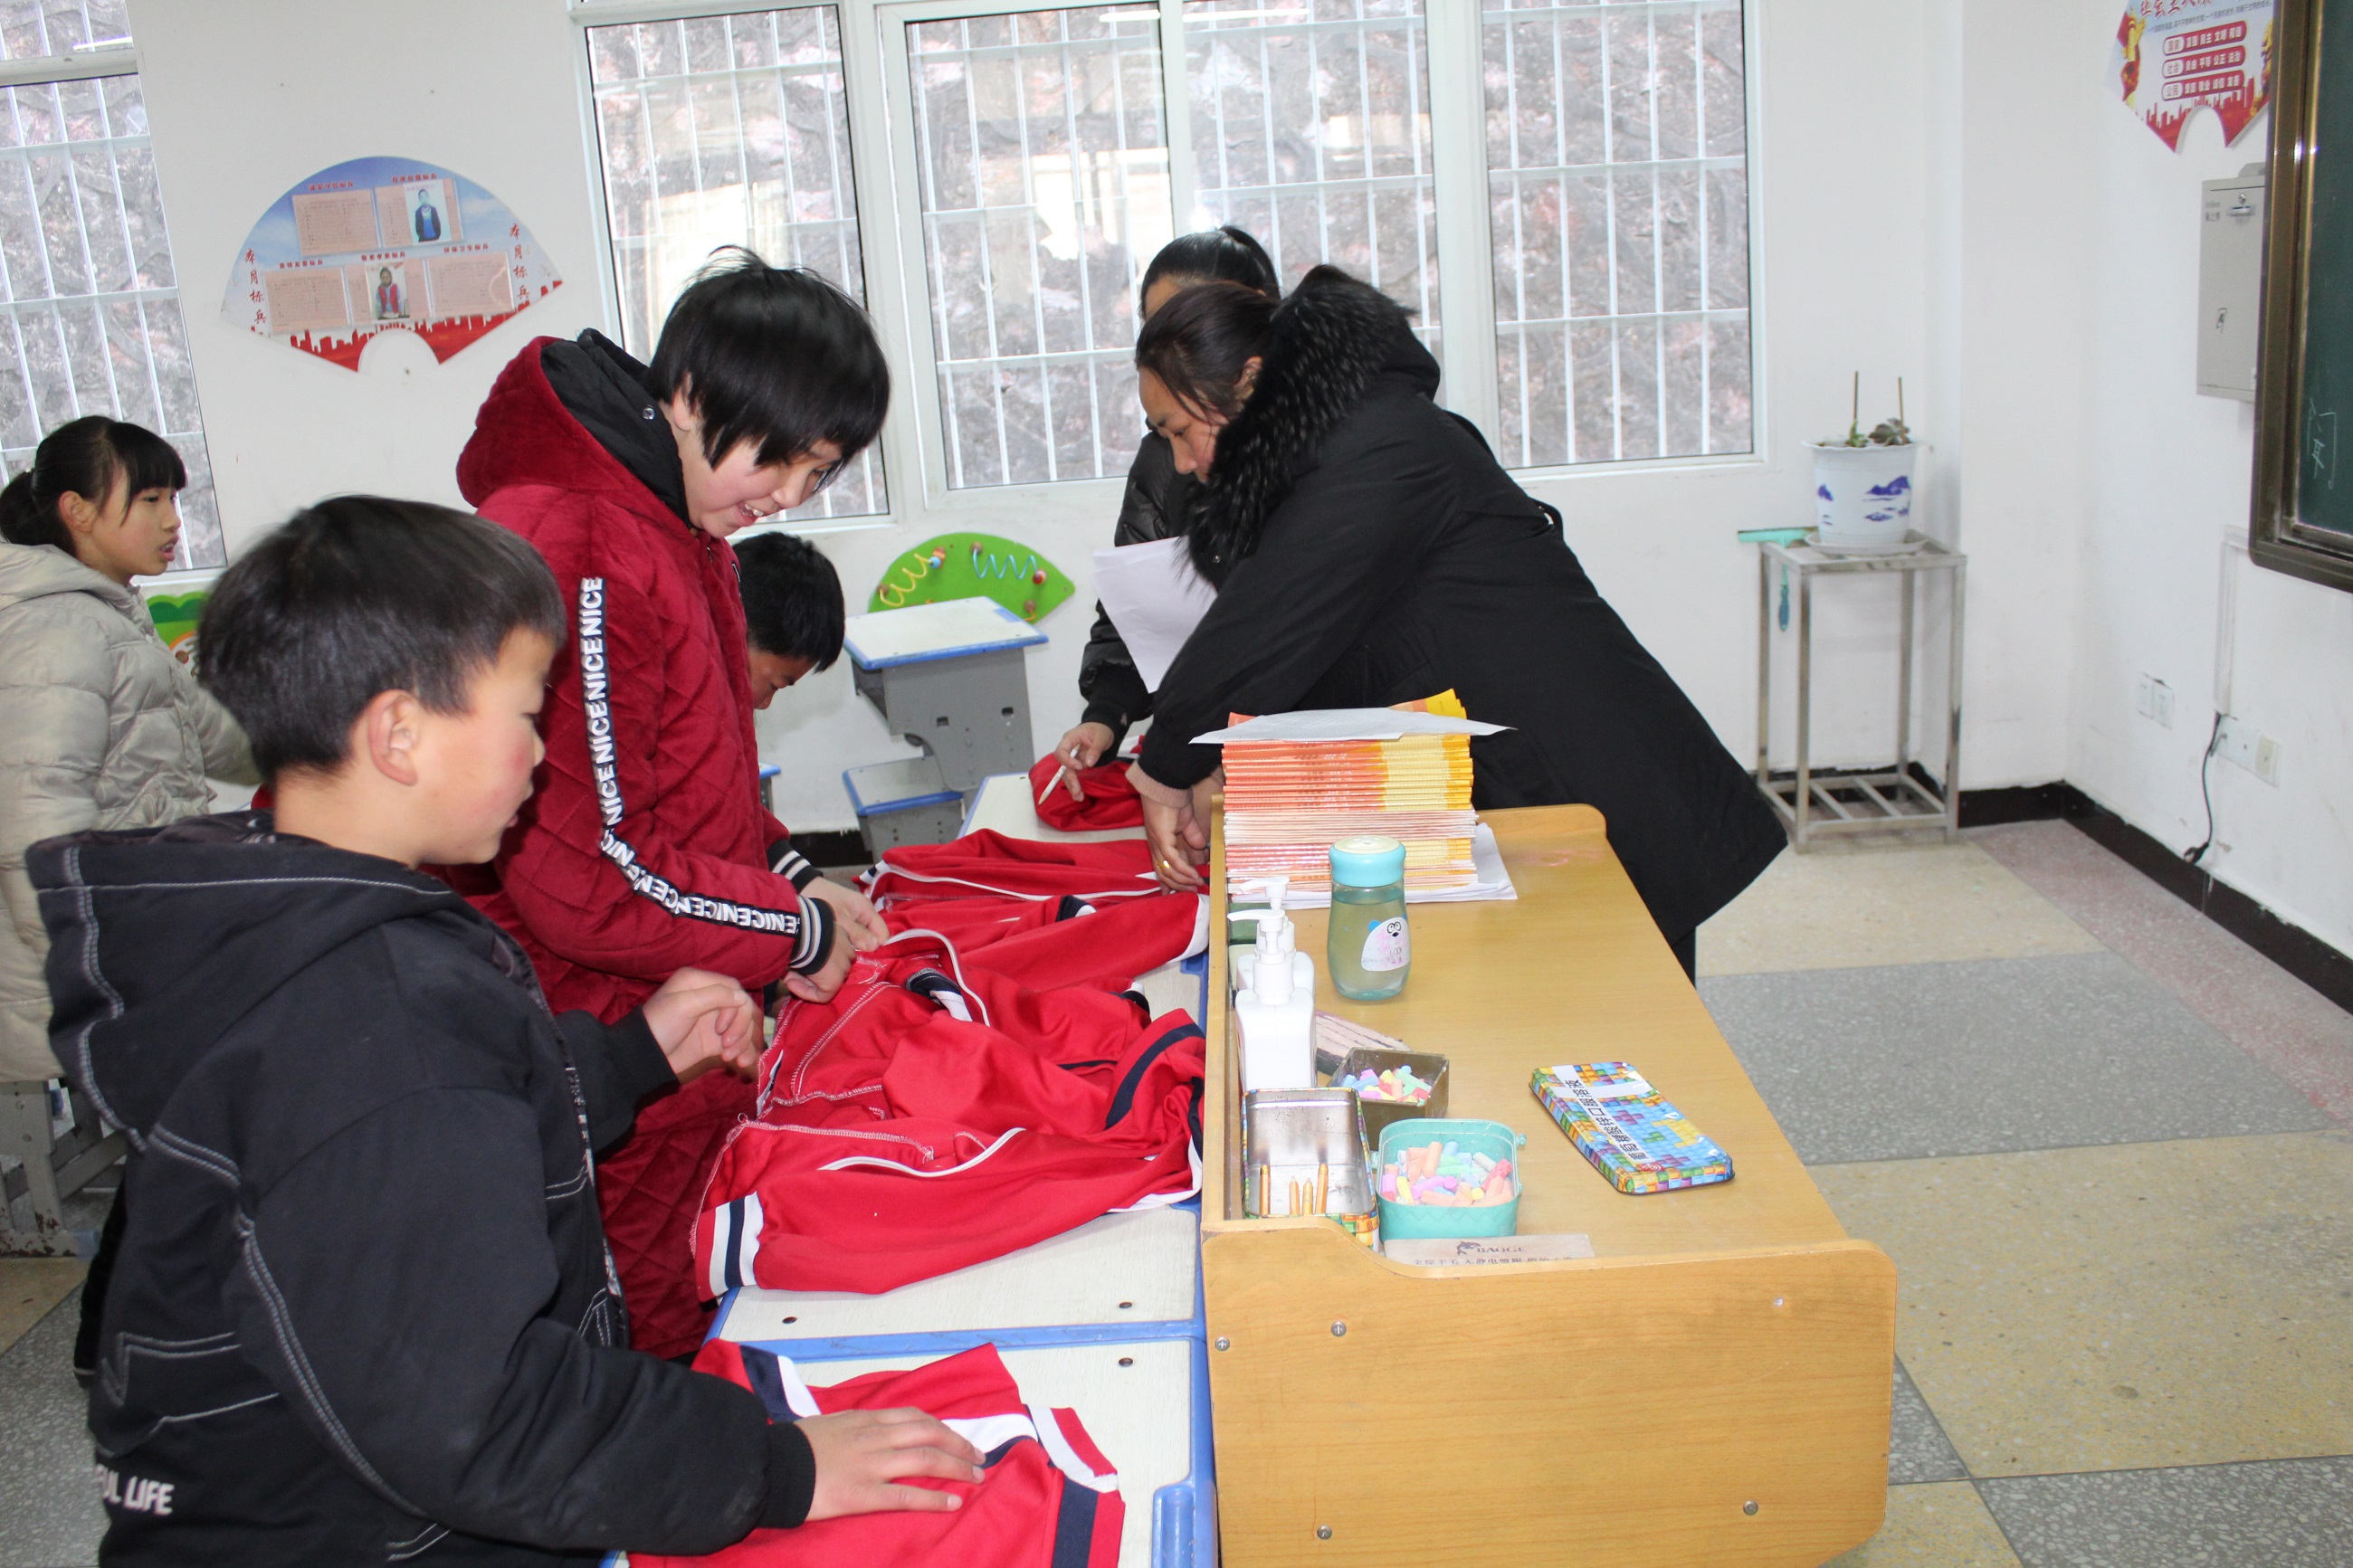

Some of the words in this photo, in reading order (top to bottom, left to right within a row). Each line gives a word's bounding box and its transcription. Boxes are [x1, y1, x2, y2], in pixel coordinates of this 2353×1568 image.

[244, 248, 267, 325] 本月标兵
[510, 223, 530, 299] 本月标兵
[1565, 1079, 1650, 1161] 葡萄糖酸锌口服溶液
[123, 1476, 175, 1516] LIFE
